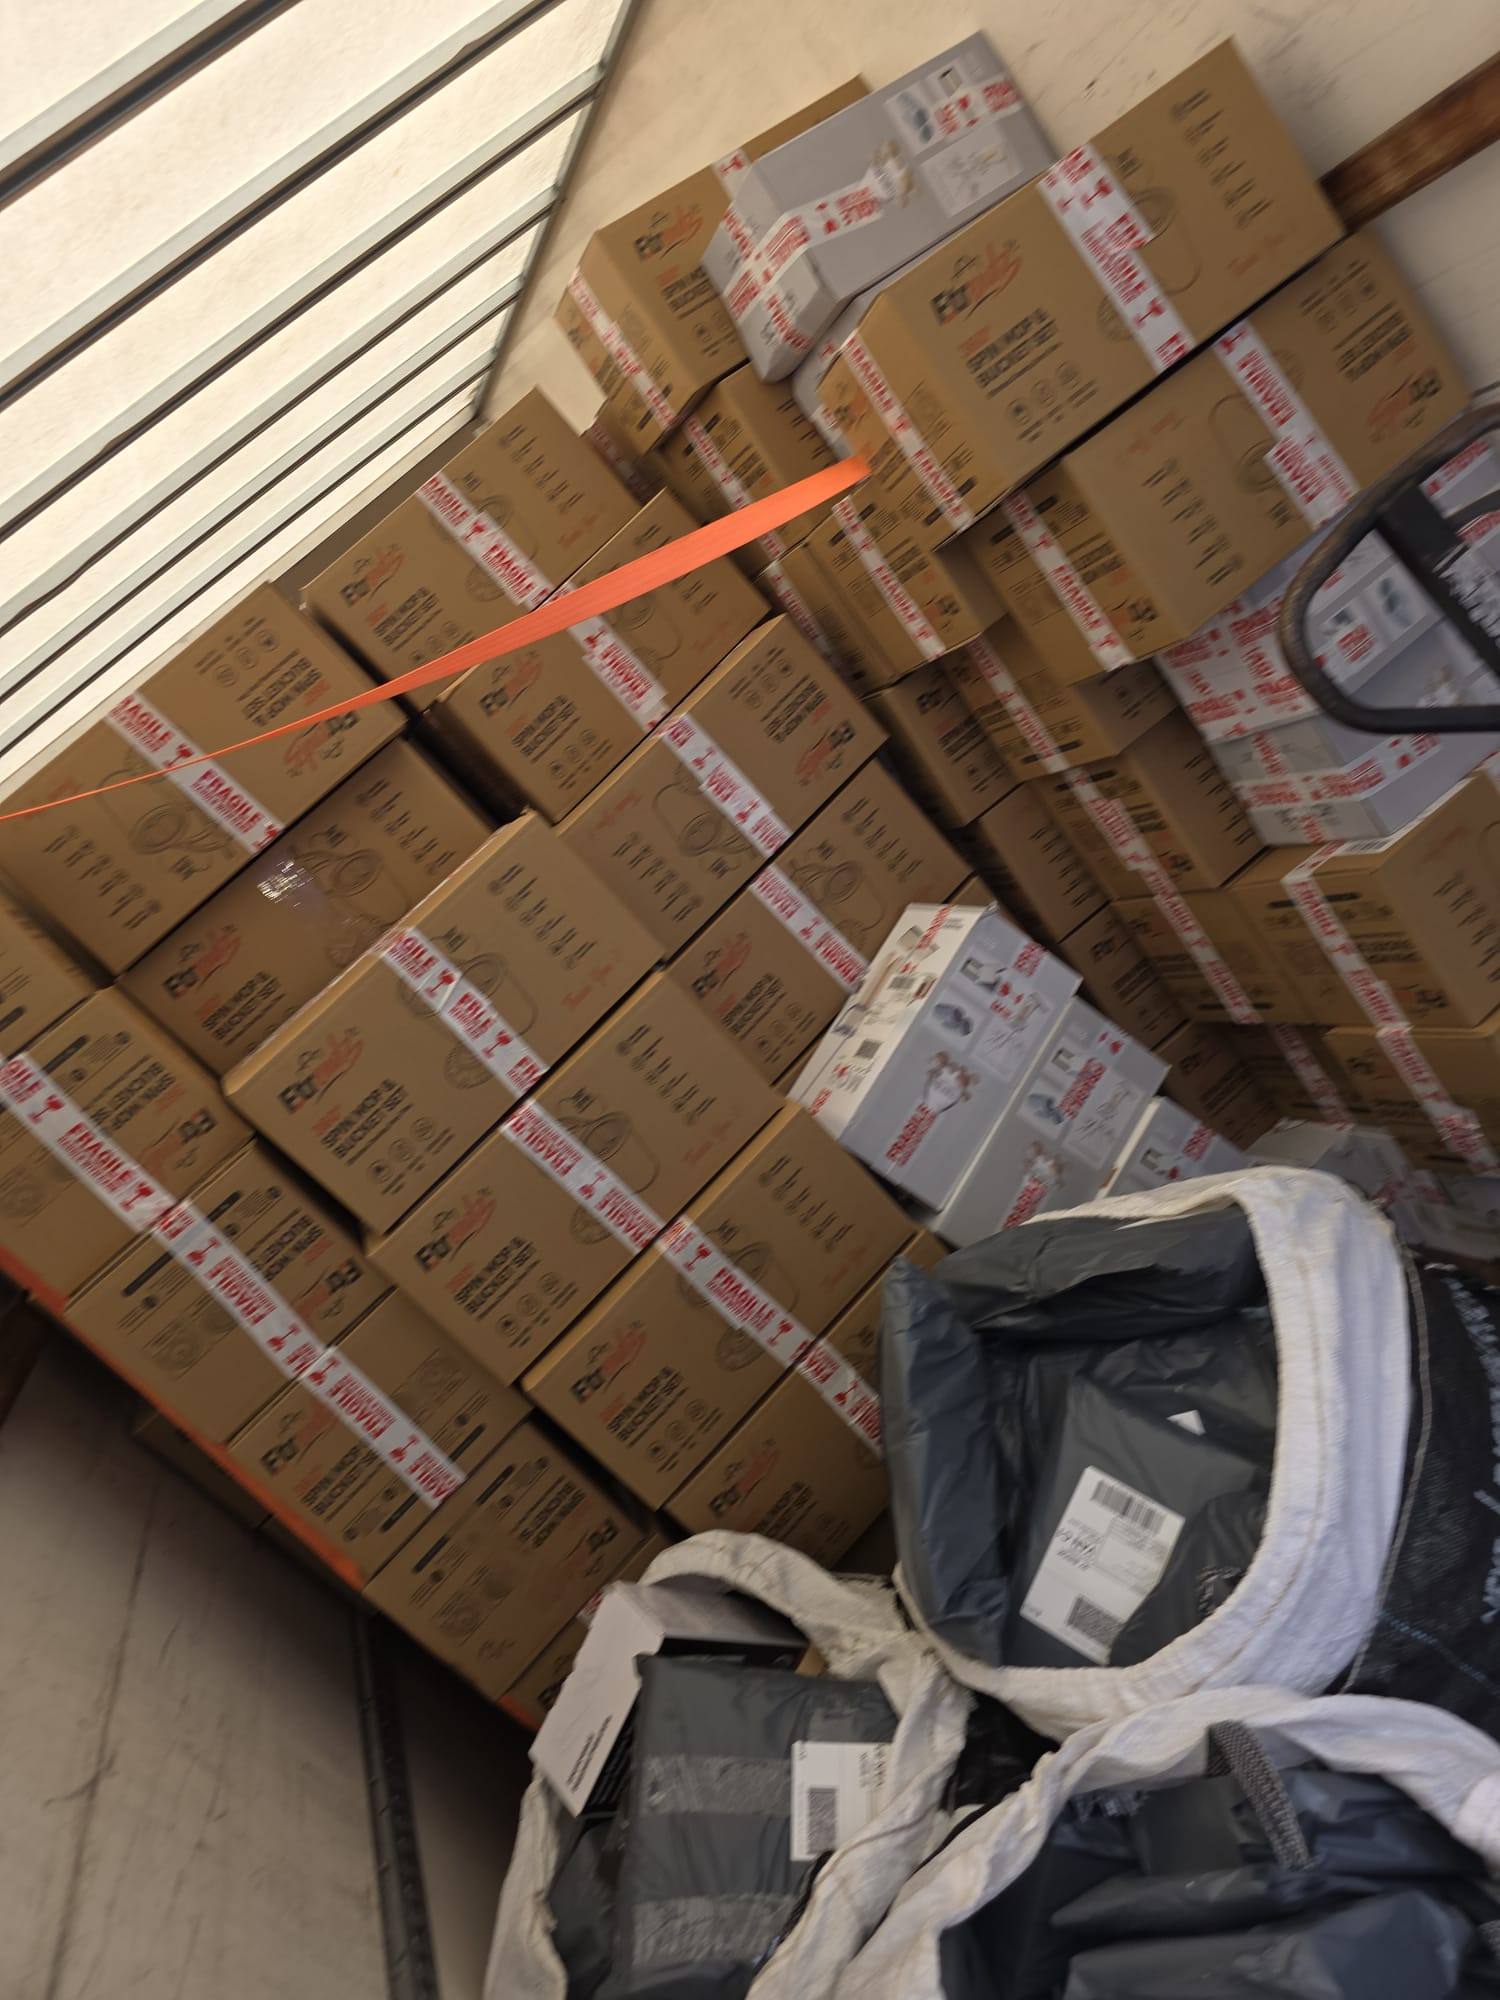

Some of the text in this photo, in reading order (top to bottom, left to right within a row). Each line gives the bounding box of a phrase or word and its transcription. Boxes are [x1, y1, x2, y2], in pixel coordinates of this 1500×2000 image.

[199, 766, 263, 827] FRAGILE
[67, 1121, 137, 1185] FRAGILE
[206, 1263, 267, 1328] FRAGILE
[325, 1380, 387, 1440] FRAGILE
